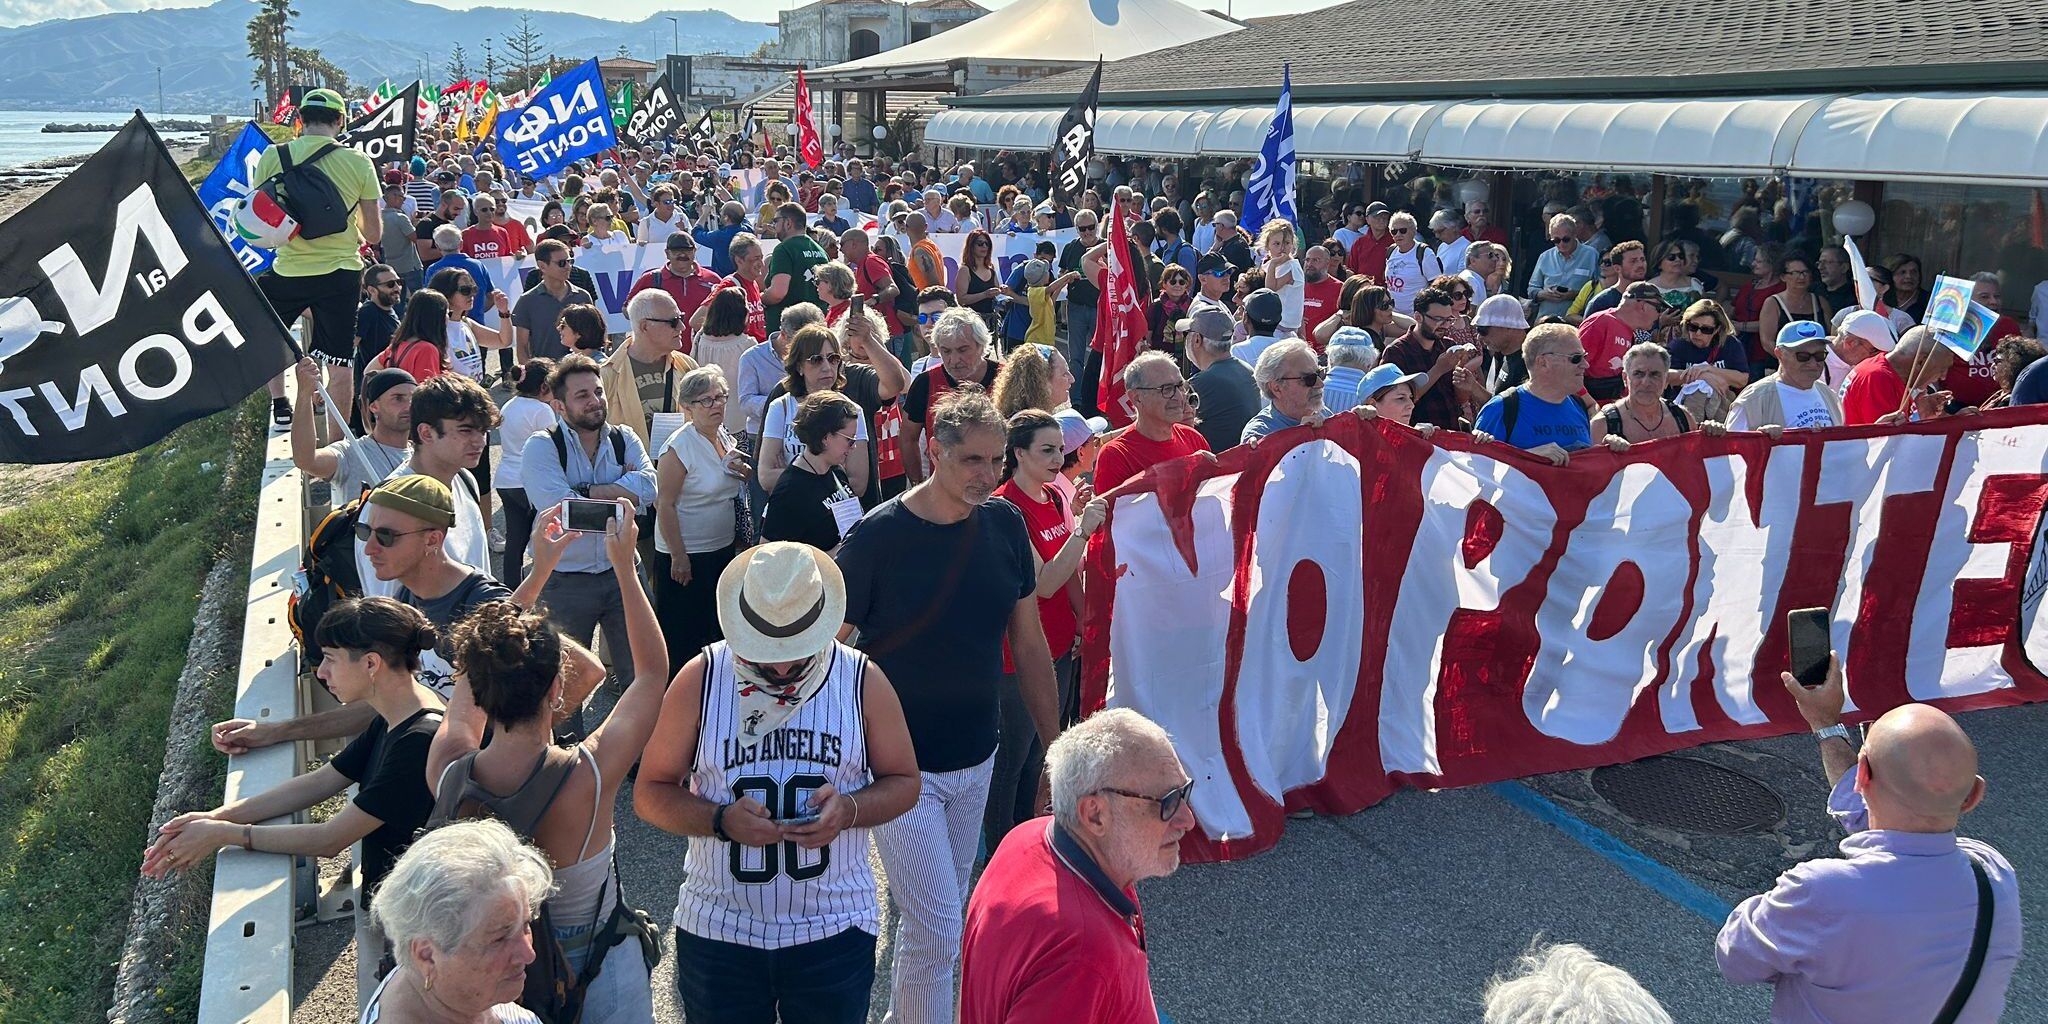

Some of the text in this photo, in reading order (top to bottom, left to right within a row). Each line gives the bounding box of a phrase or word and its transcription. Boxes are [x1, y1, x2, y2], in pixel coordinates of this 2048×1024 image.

[473, 241, 499, 252] NO
[1386, 275, 1405, 289] NO
[1615, 336, 1625, 347] NO
[1532, 424, 1552, 436] NO
[1109, 422, 2048, 841] NO PONTE
[757, 727, 843, 769] ANGELES
